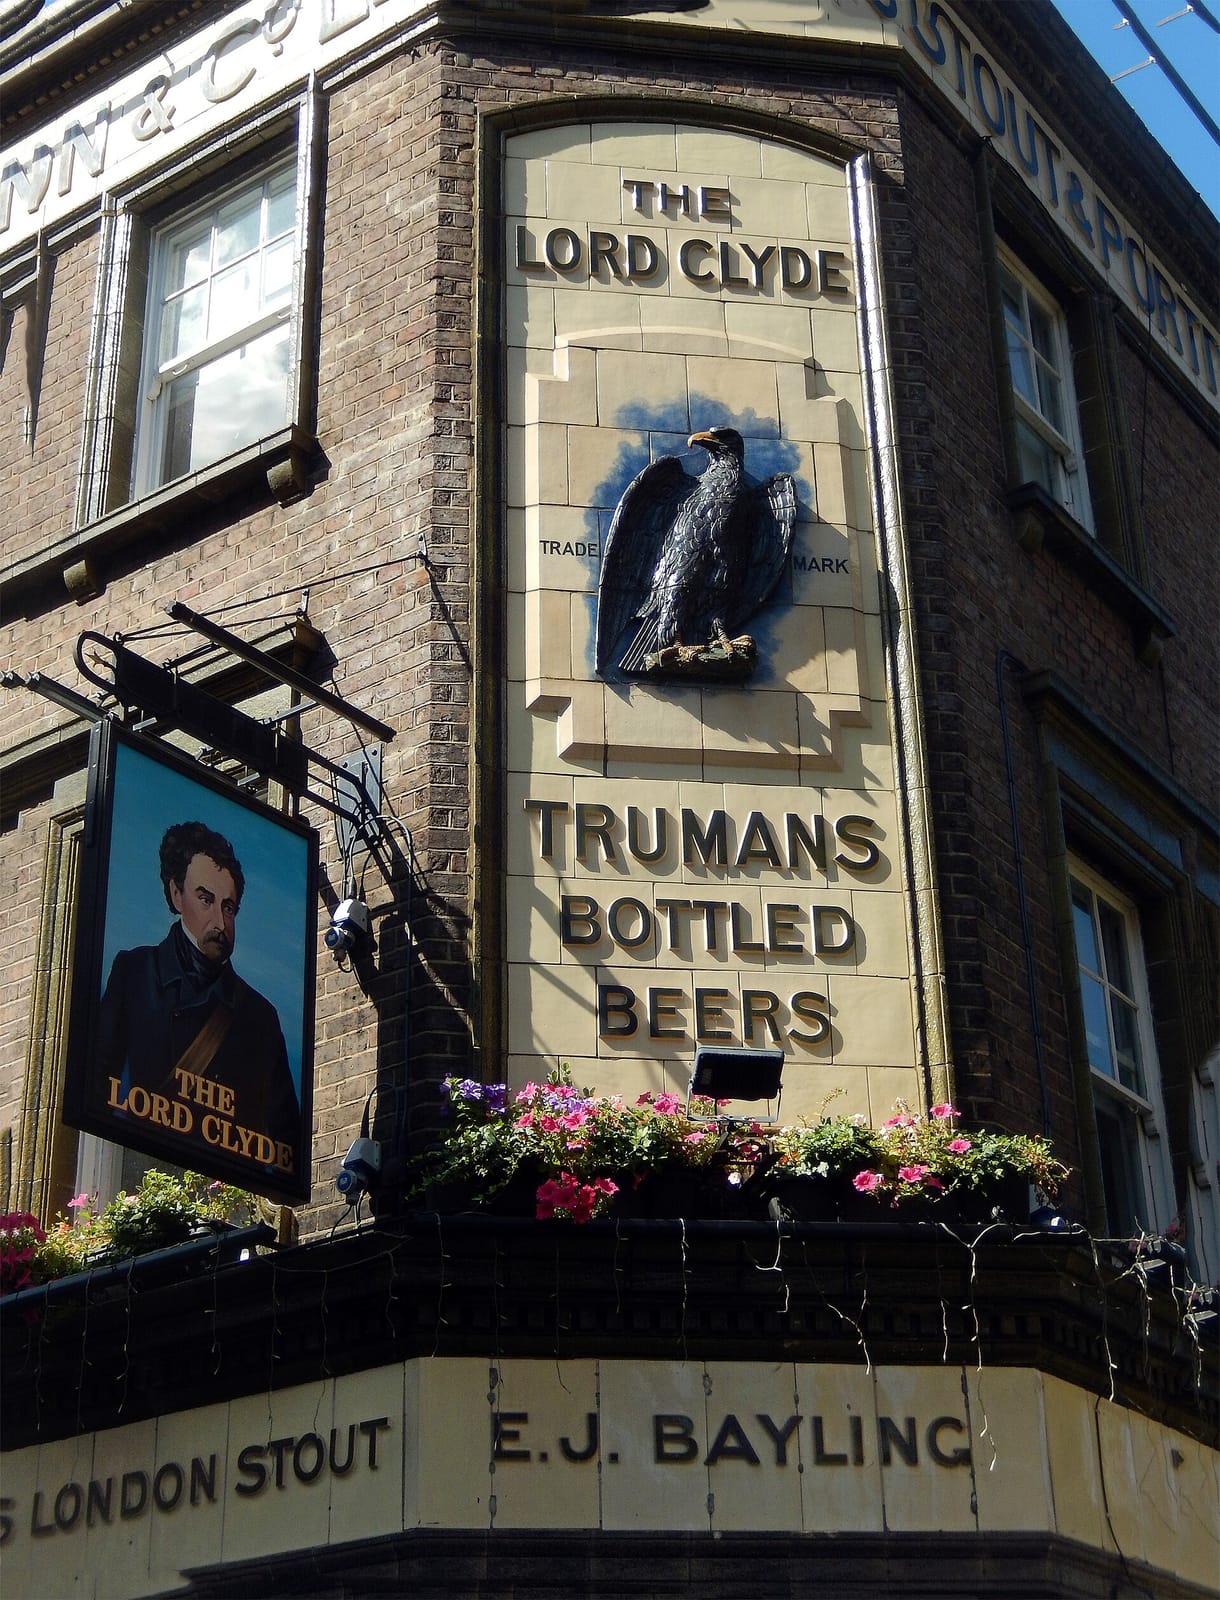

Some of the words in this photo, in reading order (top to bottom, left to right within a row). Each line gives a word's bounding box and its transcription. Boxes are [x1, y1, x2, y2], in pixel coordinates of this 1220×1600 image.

[131, 74, 176, 141] &
[909, 0, 1061, 209] STOUT
[1065, 171, 1096, 249] &
[623, 179, 731, 218] THE
[515, 224, 660, 280] LORD
[679, 238, 848, 295] CLYDE
[540, 539, 598, 558] TRADE
[793, 555, 850, 575] MARK
[523, 799, 880, 871] TRUMANS
[561, 895, 856, 956] BOTTLED
[599, 985, 833, 1043] BEERS
[175, 1066, 236, 1118] THE
[107, 1076, 194, 1134] LORD
[201, 1114, 295, 1174] CLYDE
[654, 1413, 972, 1469] BAYLING
[31, 1454, 217, 1536] LONDON
[235, 1417, 391, 1496] STOUT
